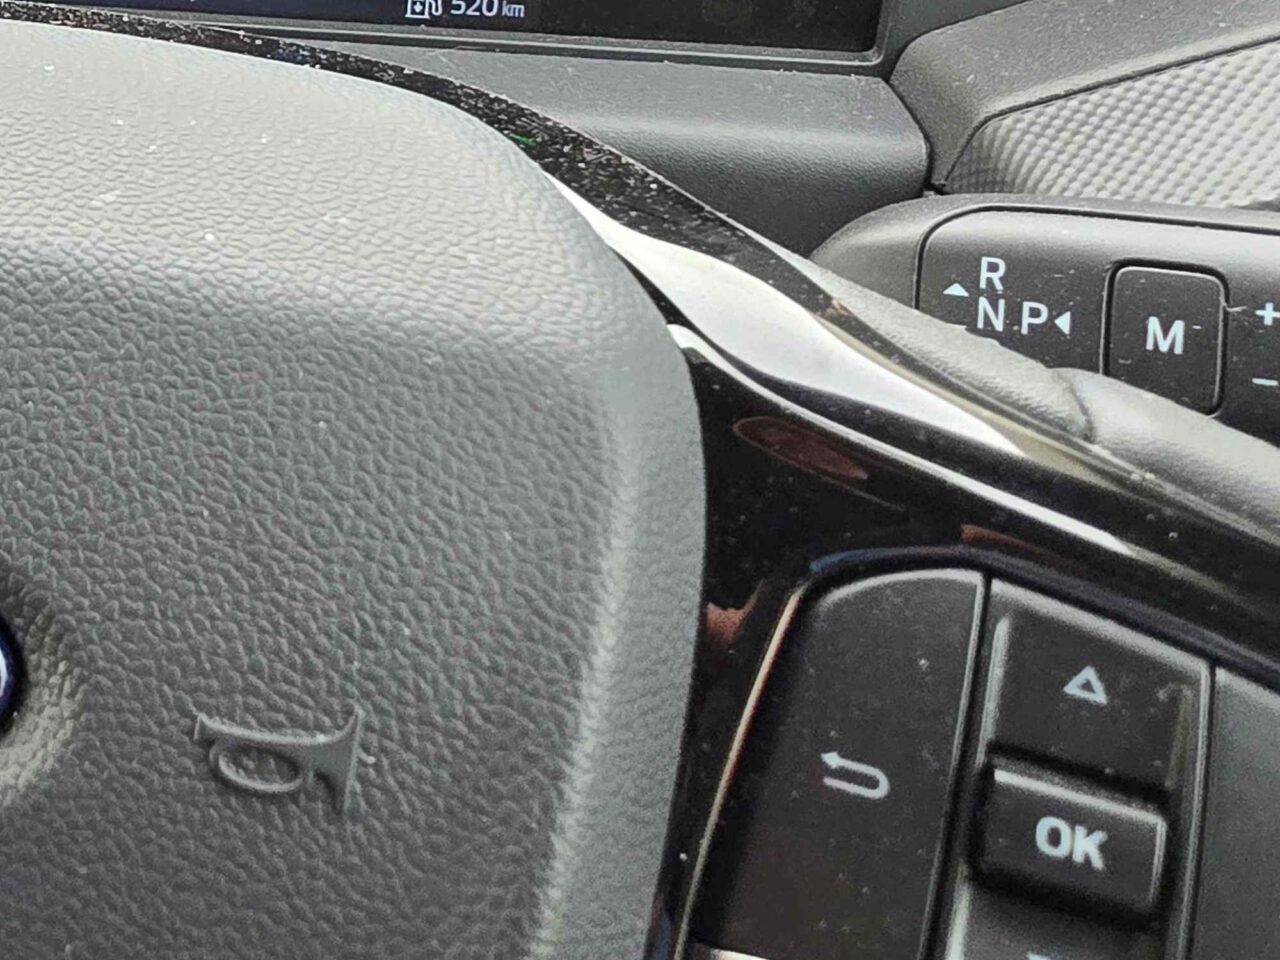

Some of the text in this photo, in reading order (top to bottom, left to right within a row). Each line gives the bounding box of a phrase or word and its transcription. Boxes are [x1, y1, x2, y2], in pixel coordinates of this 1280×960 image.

[501, 1, 525, 18] km
[979, 256, 1006, 290] R
[977, 296, 1049, 336] N P
[1145, 316, 1186, 355] M
[1034, 815, 1110, 871] OK
